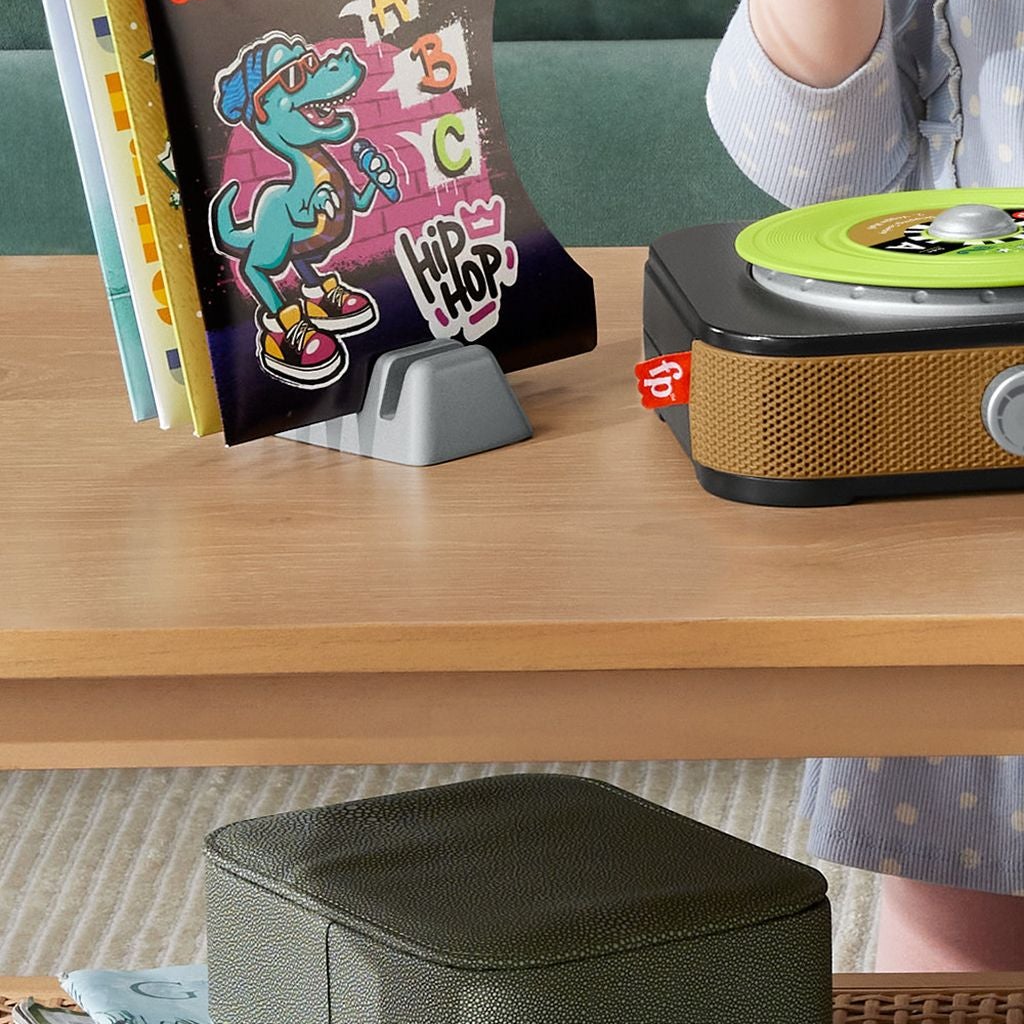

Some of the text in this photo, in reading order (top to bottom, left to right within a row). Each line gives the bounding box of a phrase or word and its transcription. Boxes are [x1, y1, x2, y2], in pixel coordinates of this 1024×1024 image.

[410, 32, 458, 94] B
[432, 114, 473, 178] C
[438, 244, 501, 320] HOP
[644, 360, 684, 399] fp
[129, 980, 197, 1000] G
